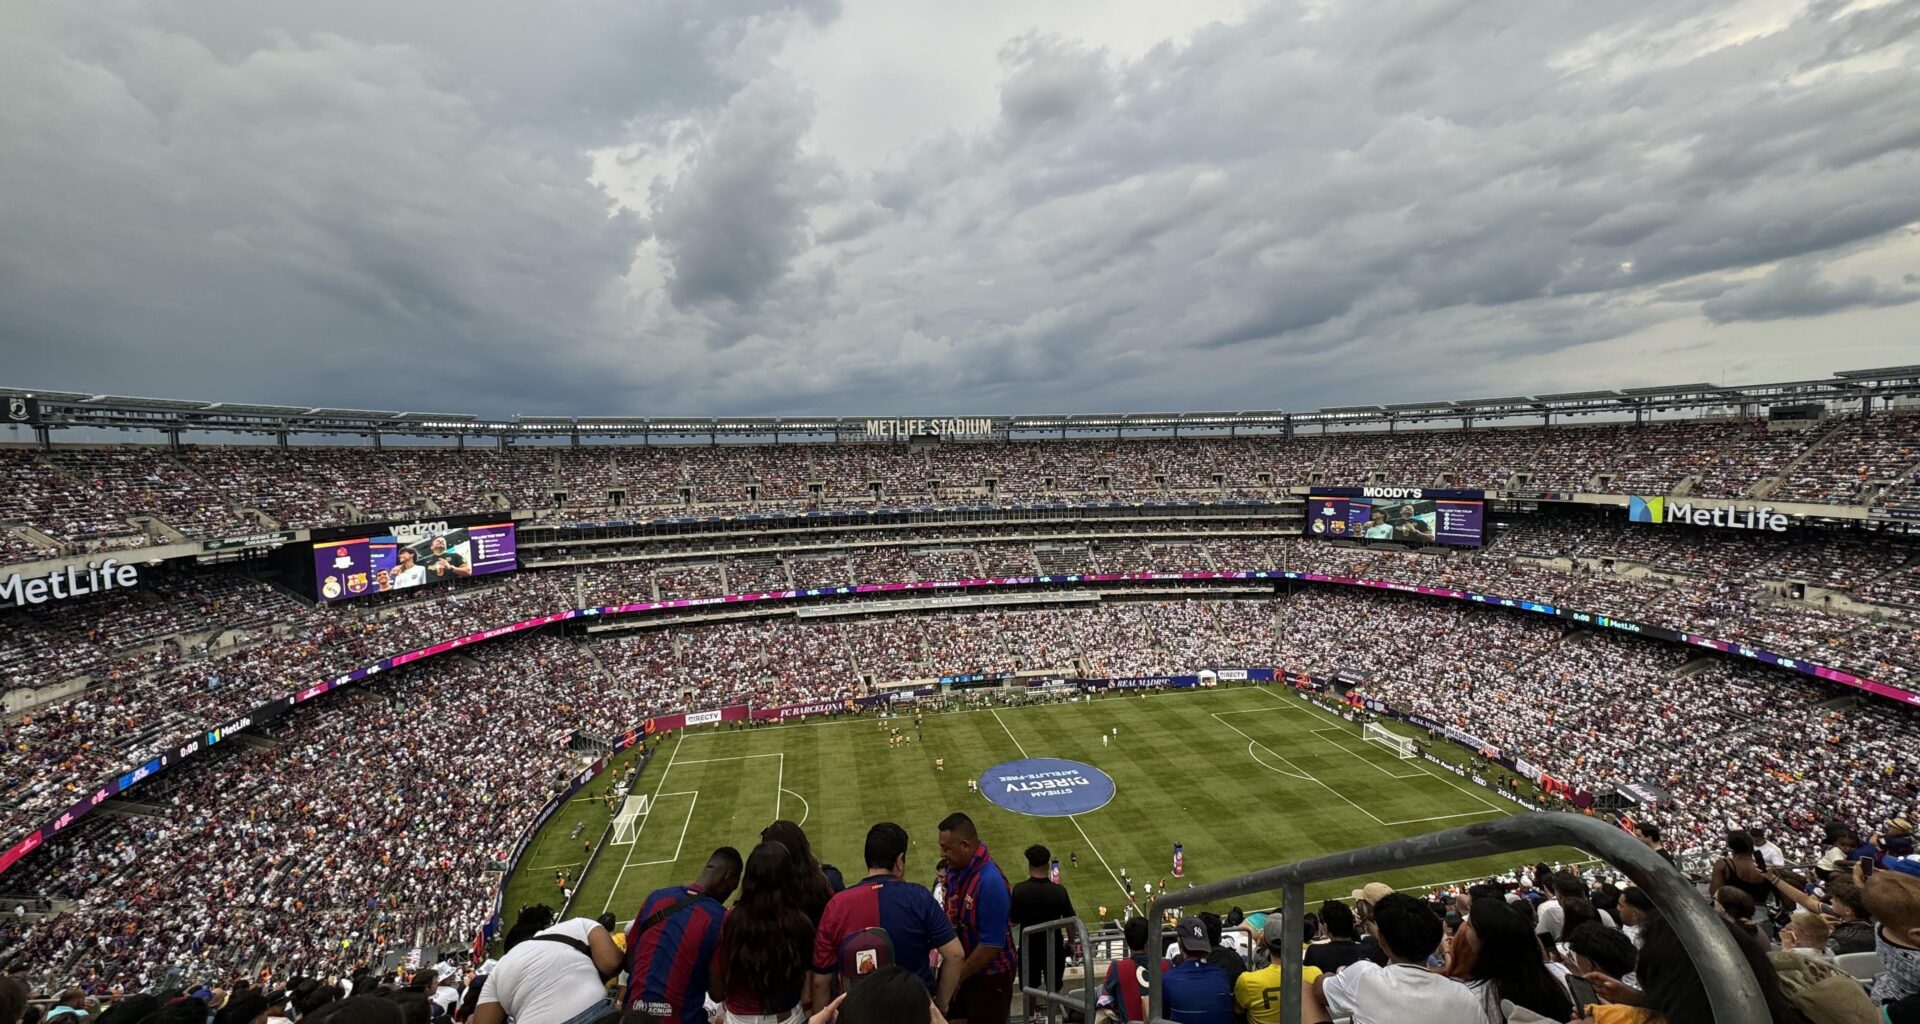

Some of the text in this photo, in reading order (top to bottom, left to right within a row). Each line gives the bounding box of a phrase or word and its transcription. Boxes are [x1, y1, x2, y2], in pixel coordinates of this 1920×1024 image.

[866, 418, 992, 436] METLIFE STADIUM
[1363, 487, 1422, 498] MOODY'S
[1667, 502, 1789, 532] MetLife
[389, 520, 448, 537] verizon
[0, 559, 138, 606] MetLife
[1573, 613, 1590, 622] 0:00
[1610, 620, 1640, 632] MetLife
[1220, 671, 1244, 679] DIRECTV
[1117, 679, 1138, 687] REAL
[688, 712, 719, 722] DIRECTV
[780, 702, 843, 717] FC BARCELONA
[221, 717, 251, 738] MetLife
[180, 741, 199, 758] 0:00
[161, 756, 167, 766] 0
[1424, 752, 1440, 765] 2024
[1440, 761, 1455, 771] Audi
[999, 769, 1079, 782] SATELLITE-FREE
[1006, 776, 1089, 793] DIRECTV
[1030, 788, 1073, 798] STREAM
[1497, 788, 1517, 802] 2024
[1517, 798, 1535, 811] Audi
